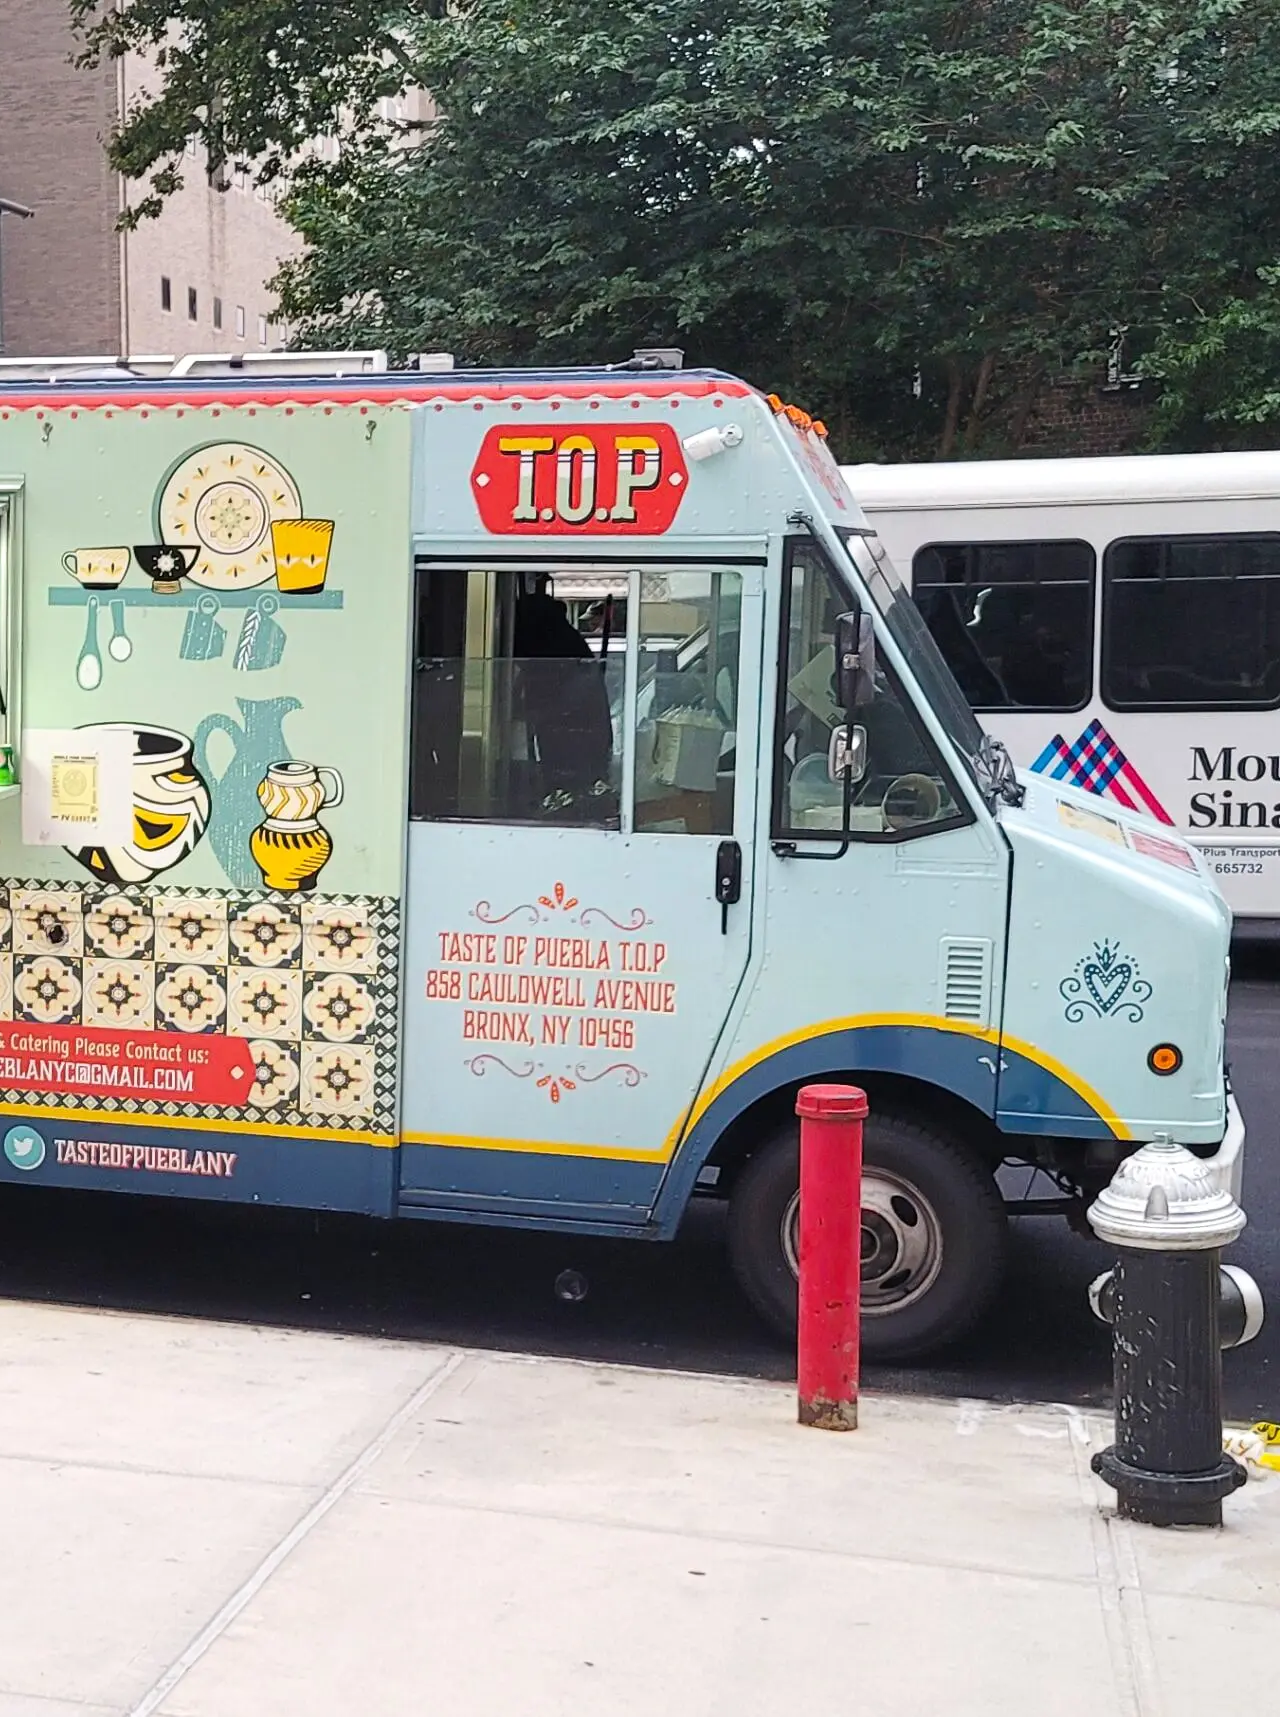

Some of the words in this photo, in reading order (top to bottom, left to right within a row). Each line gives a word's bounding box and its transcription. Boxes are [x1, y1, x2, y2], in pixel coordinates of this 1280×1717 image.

[499, 435, 662, 524] T.O.P
[1203, 848, 1226, 857] Plus
[1215, 863, 1263, 874] 665732
[438, 932, 496, 963] TASTE
[503, 936, 527, 966] OF
[533, 937, 610, 970] PUEBLA
[618, 941, 667, 973] T.O.P
[426, 970, 461, 1000] 858
[468, 972, 586, 1007] CAULDWELL
[593, 979, 676, 1014] AVENUE
[463, 1009, 535, 1047] BRONX,
[541, 1014, 572, 1045] NY
[578, 1016, 634, 1049] 10456
[10, 1033, 70, 1058] Catering
[75, 1037, 120, 1058] Please
[125, 1041, 183, 1063] Contact
[188, 1048, 209, 1065] us:
[54, 1139, 239, 1177] TASTEOFPUEBLANY
